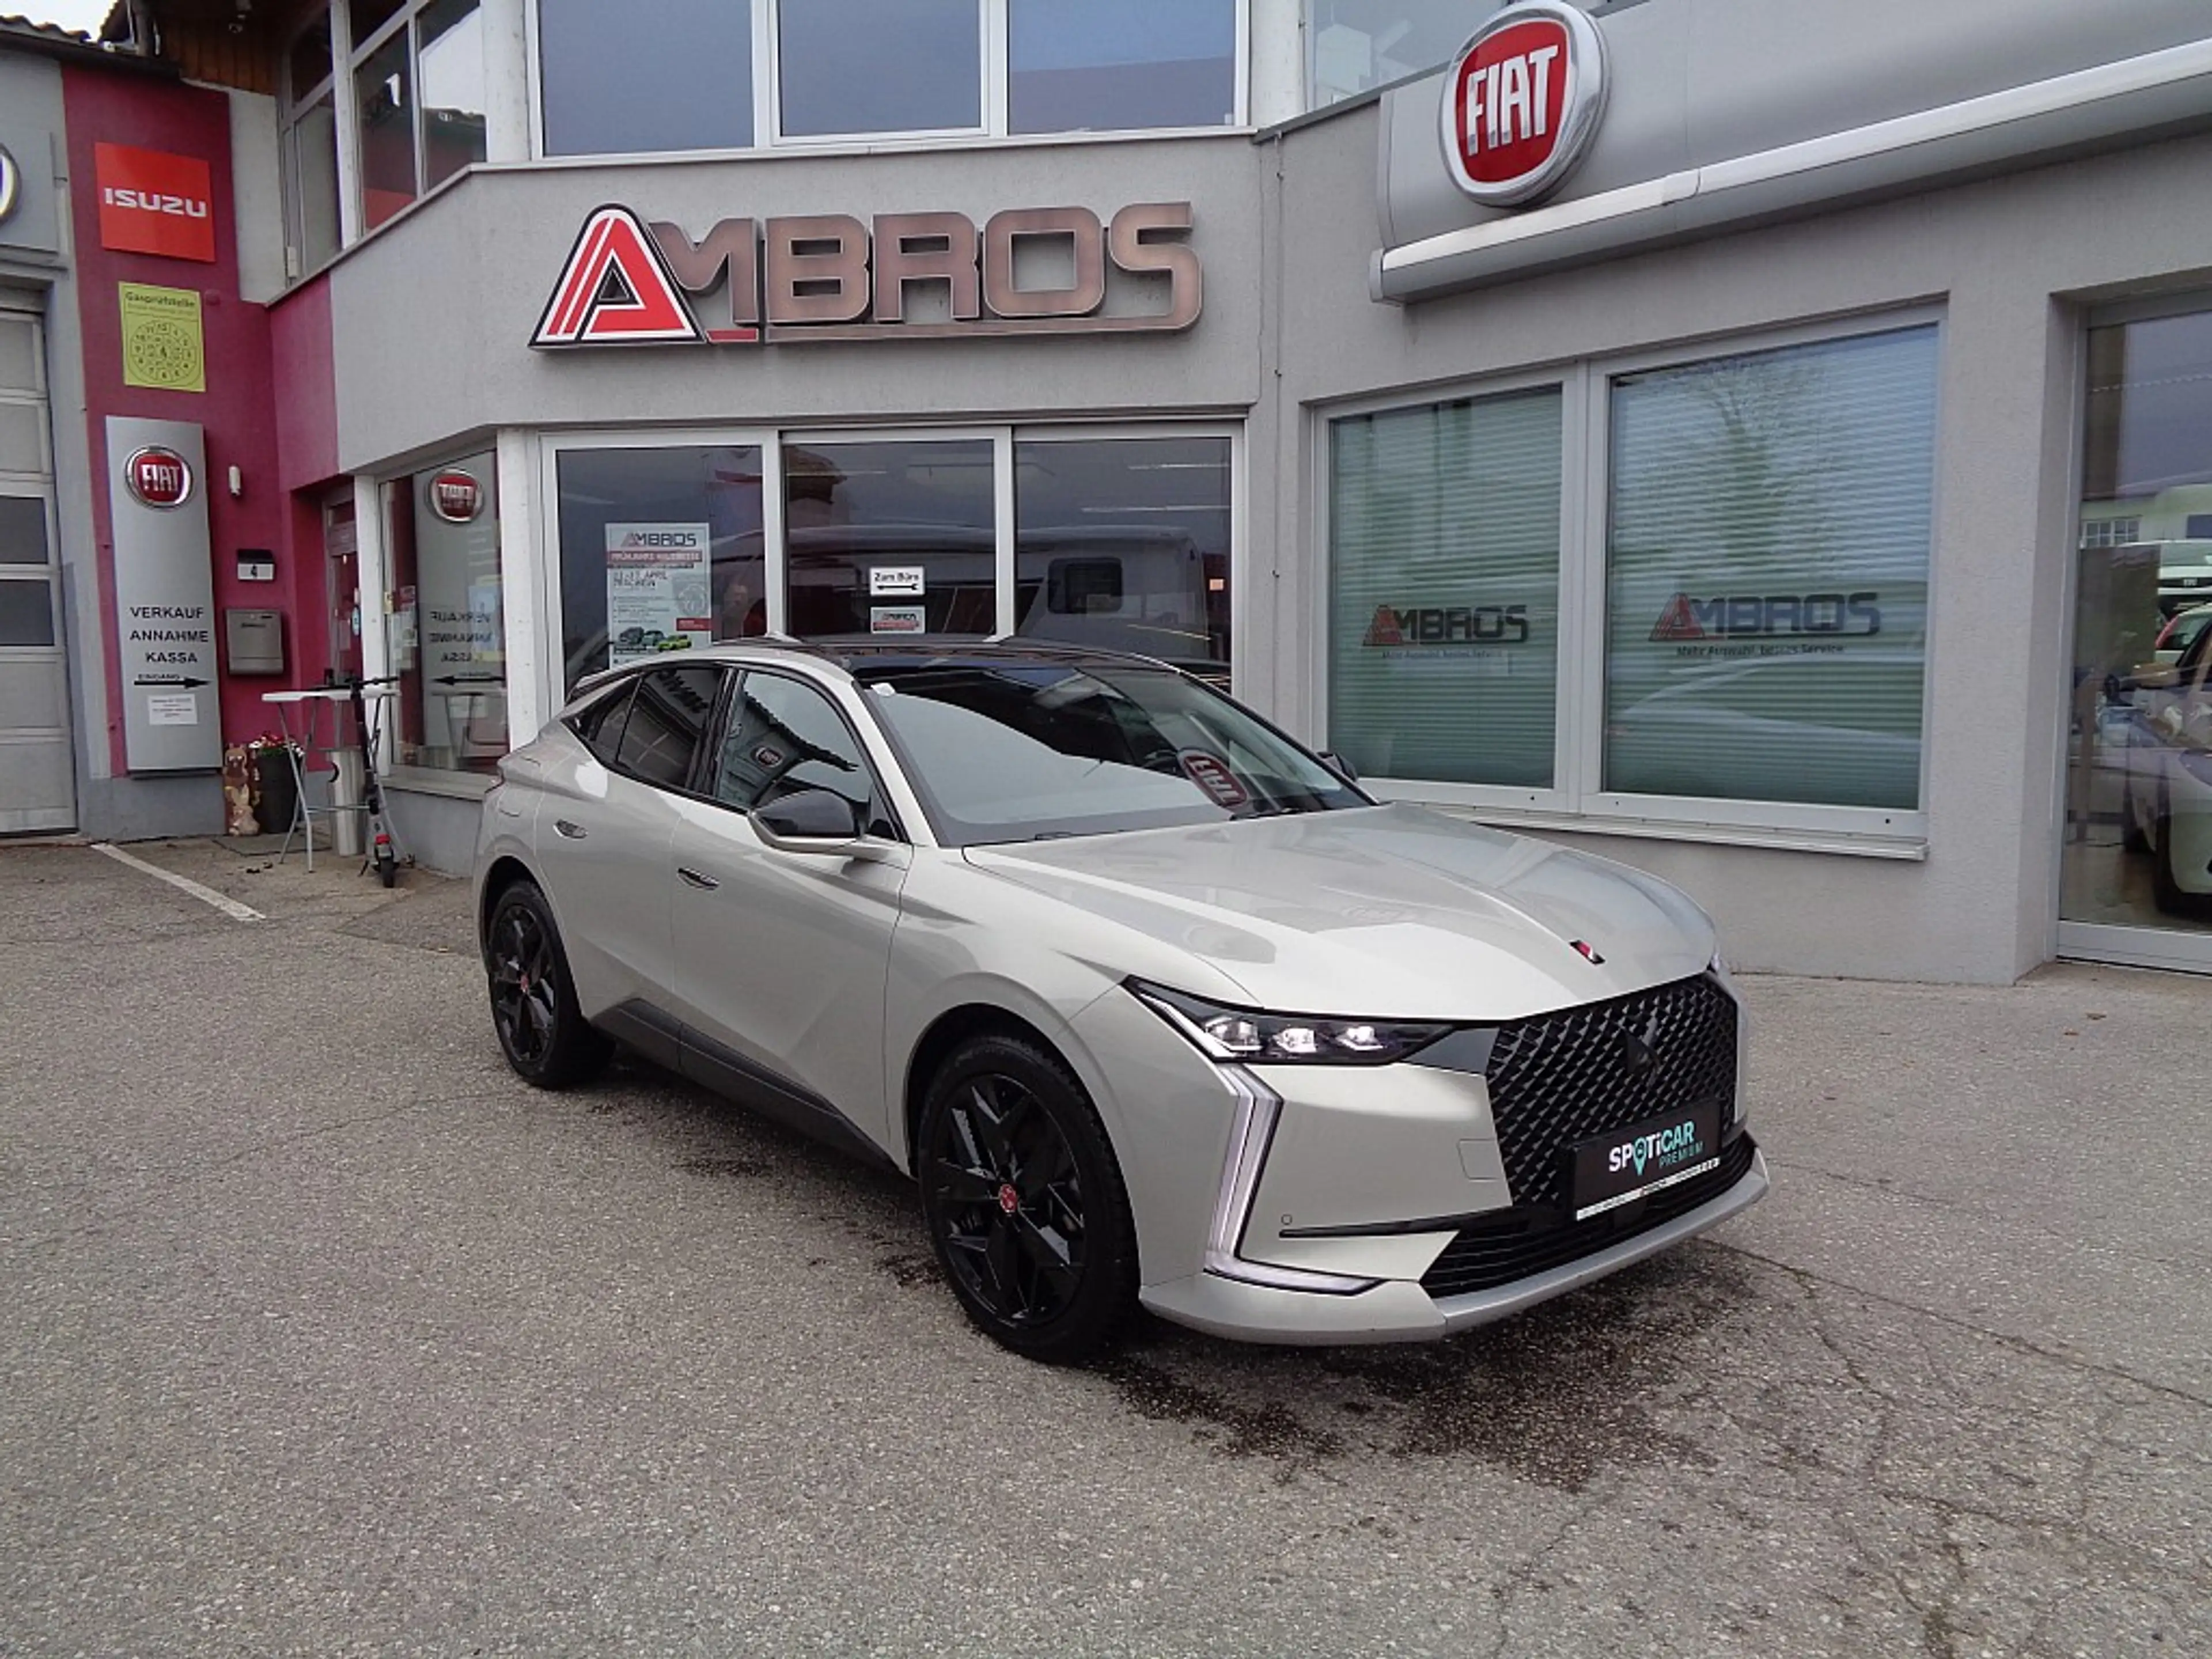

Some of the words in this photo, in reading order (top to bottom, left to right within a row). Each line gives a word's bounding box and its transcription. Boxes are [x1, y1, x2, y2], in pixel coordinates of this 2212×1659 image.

[1466, 44, 1559, 157] FIAT
[104, 187, 207, 218] ISUZU
[528, 202, 1203, 348] AMBROS
[140, 464, 180, 491] FIAT
[620, 533, 696, 548] AMBROS
[130, 607, 204, 619] VERKAUF
[1363, 604, 1529, 646] AMBROS
[1649, 592, 1881, 641] AMBROS
[130, 630, 209, 642] ANNAHME
[146, 652, 198, 663] KASSA
